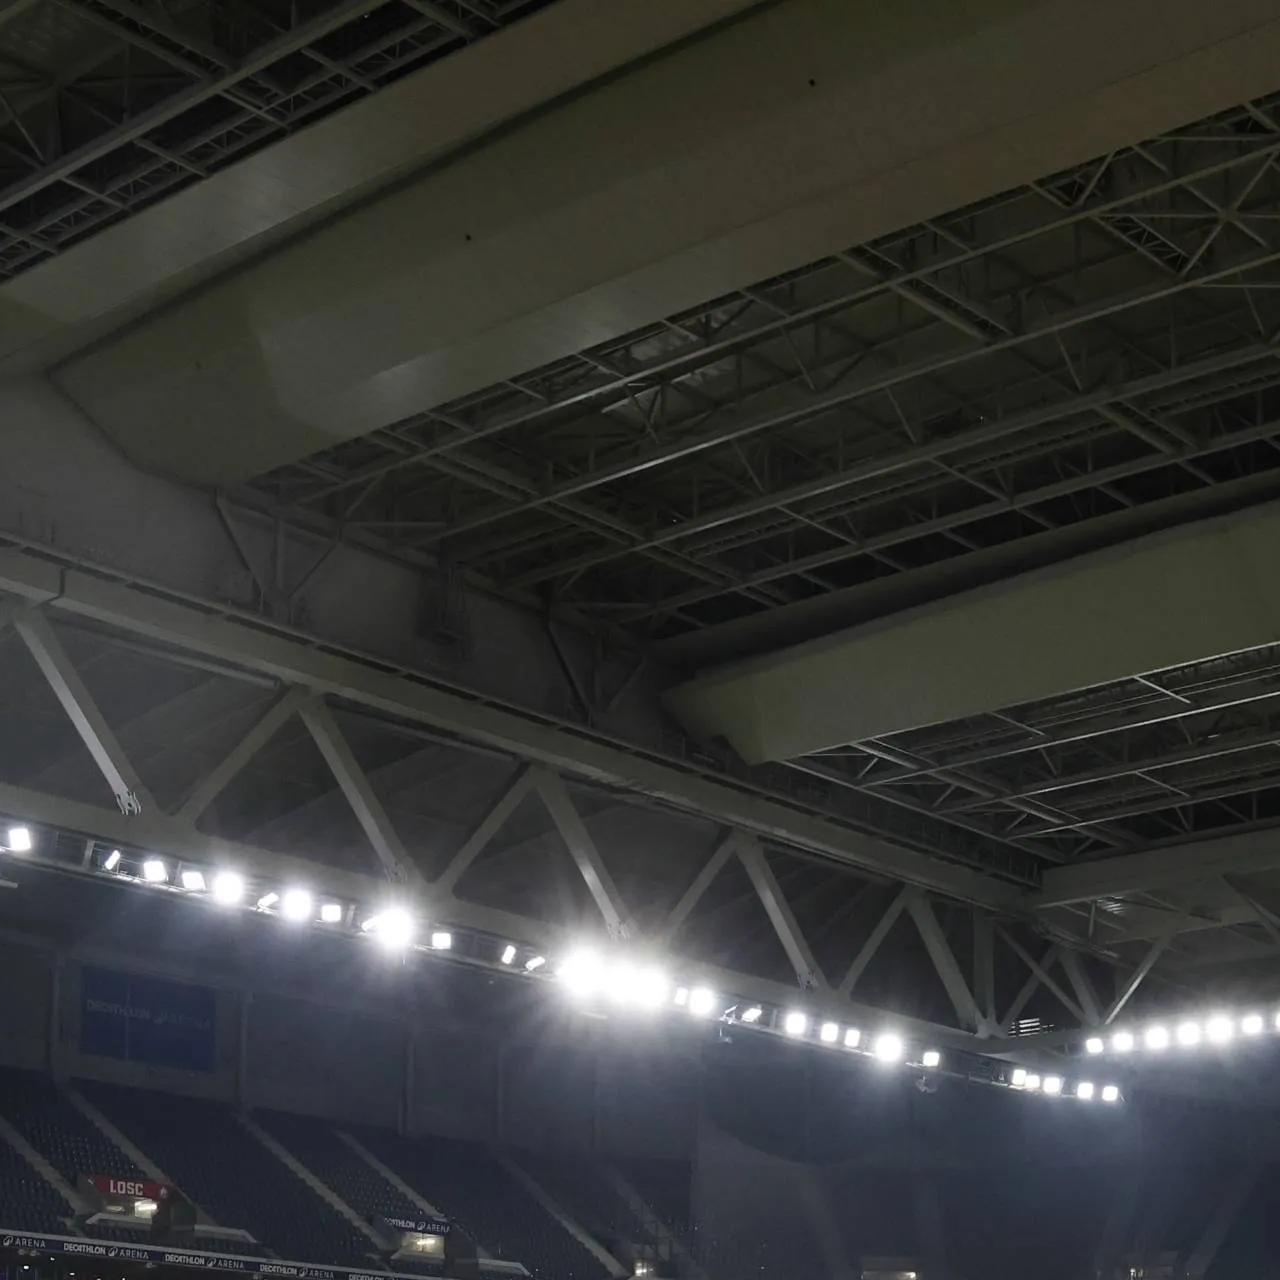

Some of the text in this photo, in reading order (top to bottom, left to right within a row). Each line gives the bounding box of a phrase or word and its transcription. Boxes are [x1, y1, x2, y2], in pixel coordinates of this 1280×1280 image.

[109, 1179, 144, 1196] LOSC
[15, 1237, 46, 1249] ARENA
[63, 1242, 149, 1260] DECATHLON ARENA
[164, 1253, 245, 1270] DECATHLON ARENA
[259, 1263, 335, 1280] DECATHLON ARENA
